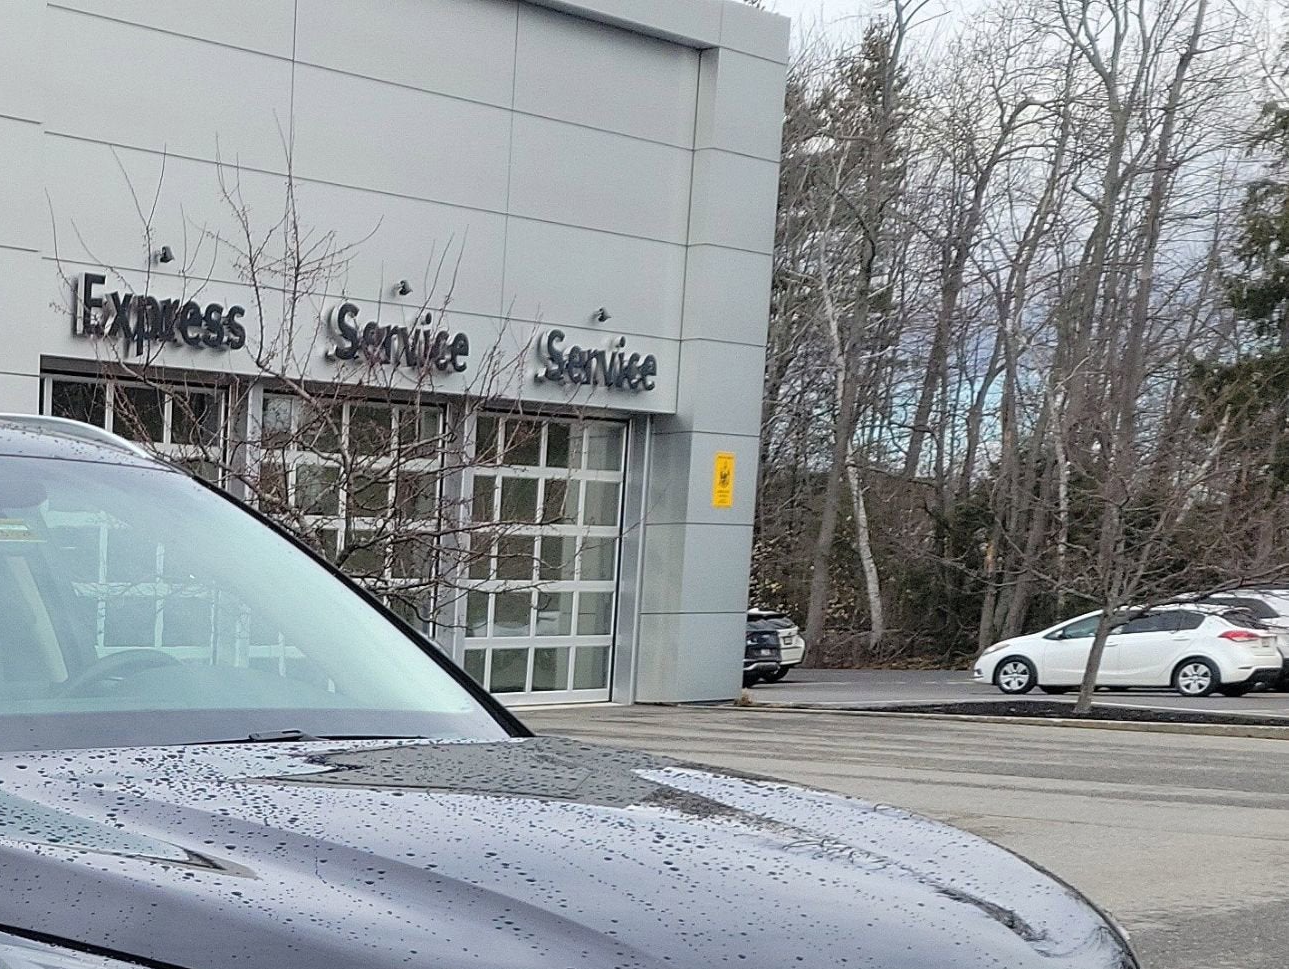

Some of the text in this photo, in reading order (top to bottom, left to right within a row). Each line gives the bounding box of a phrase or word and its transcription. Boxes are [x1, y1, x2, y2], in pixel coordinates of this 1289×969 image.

[78, 271, 246, 356] Express
[330, 302, 470, 373] Service
[539, 328, 657, 391] Service
